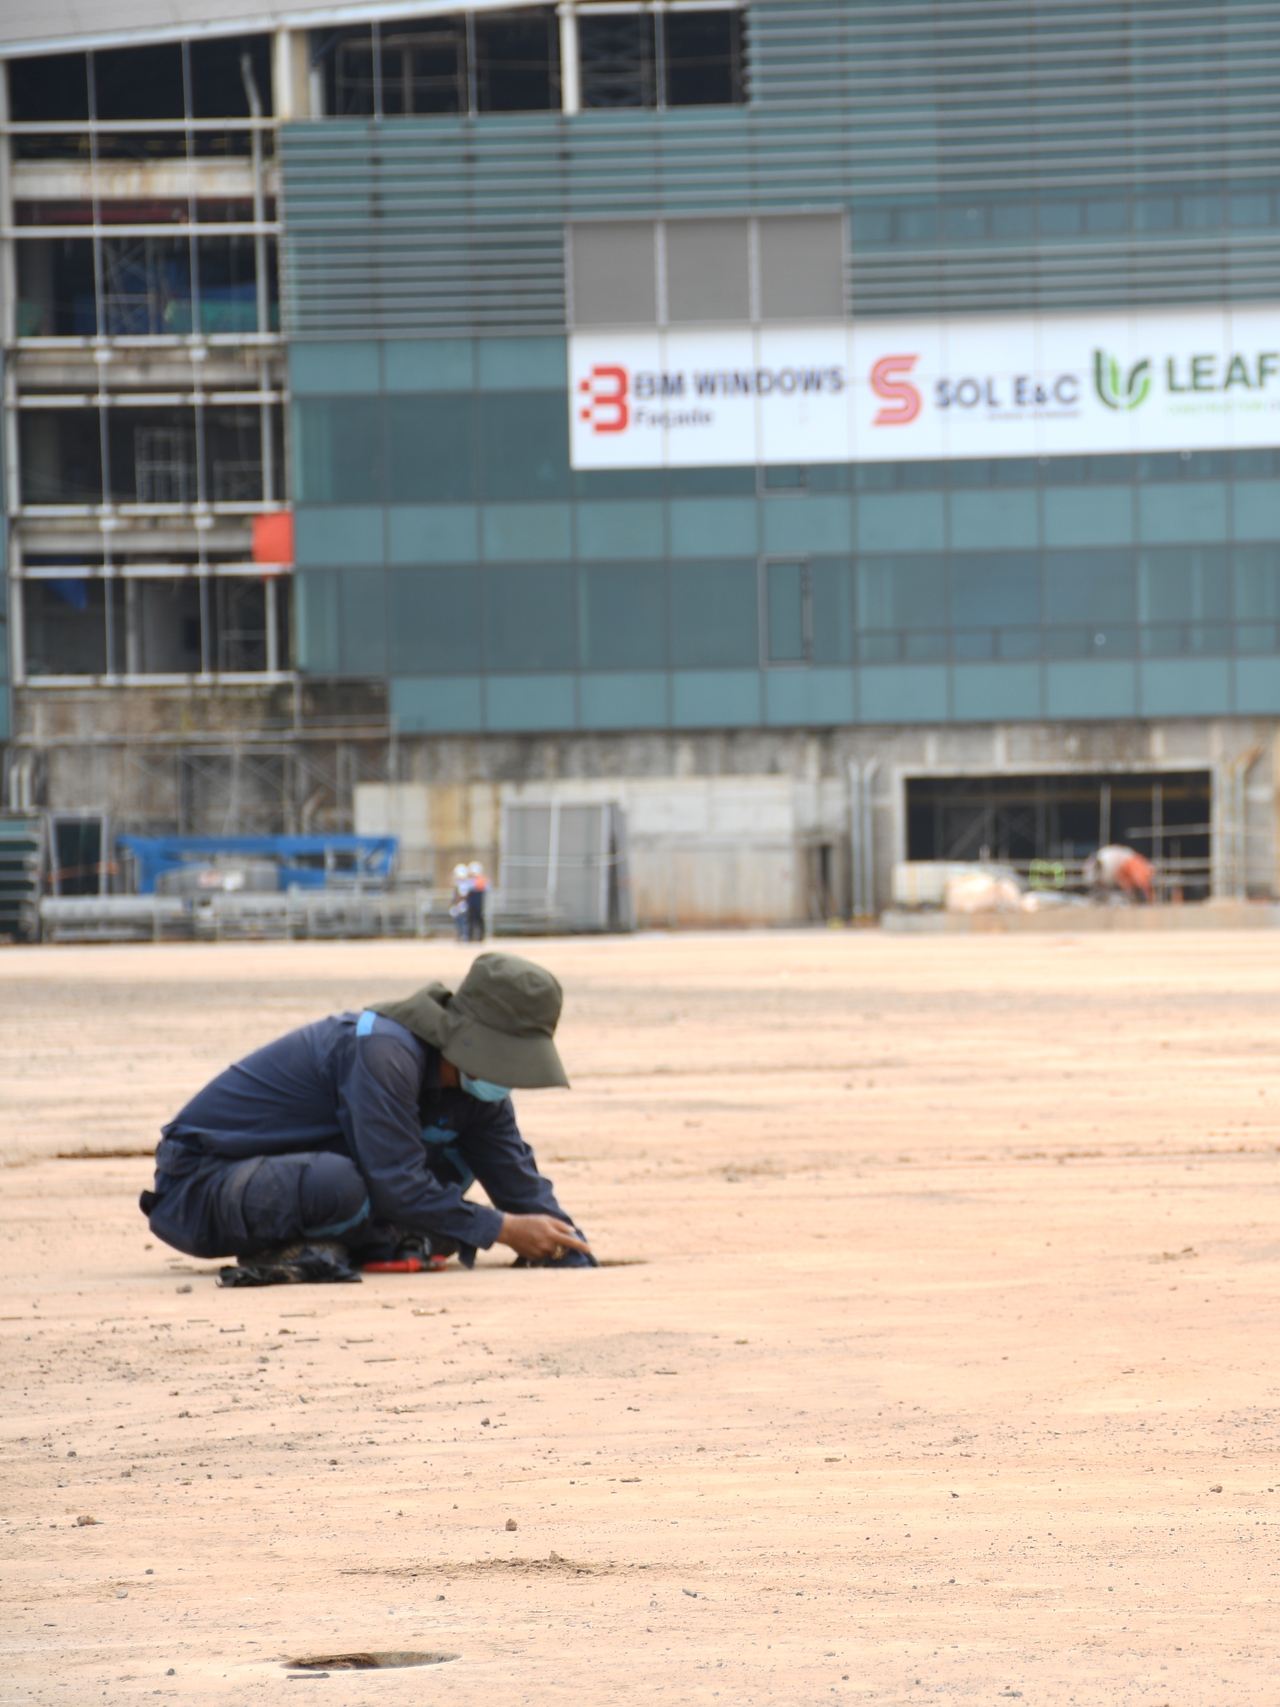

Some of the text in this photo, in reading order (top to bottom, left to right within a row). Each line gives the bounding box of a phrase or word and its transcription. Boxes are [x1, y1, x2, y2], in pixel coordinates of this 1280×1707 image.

[636, 366, 846, 399] BM WINDOWS
[935, 374, 1080, 409] SOL E&C
